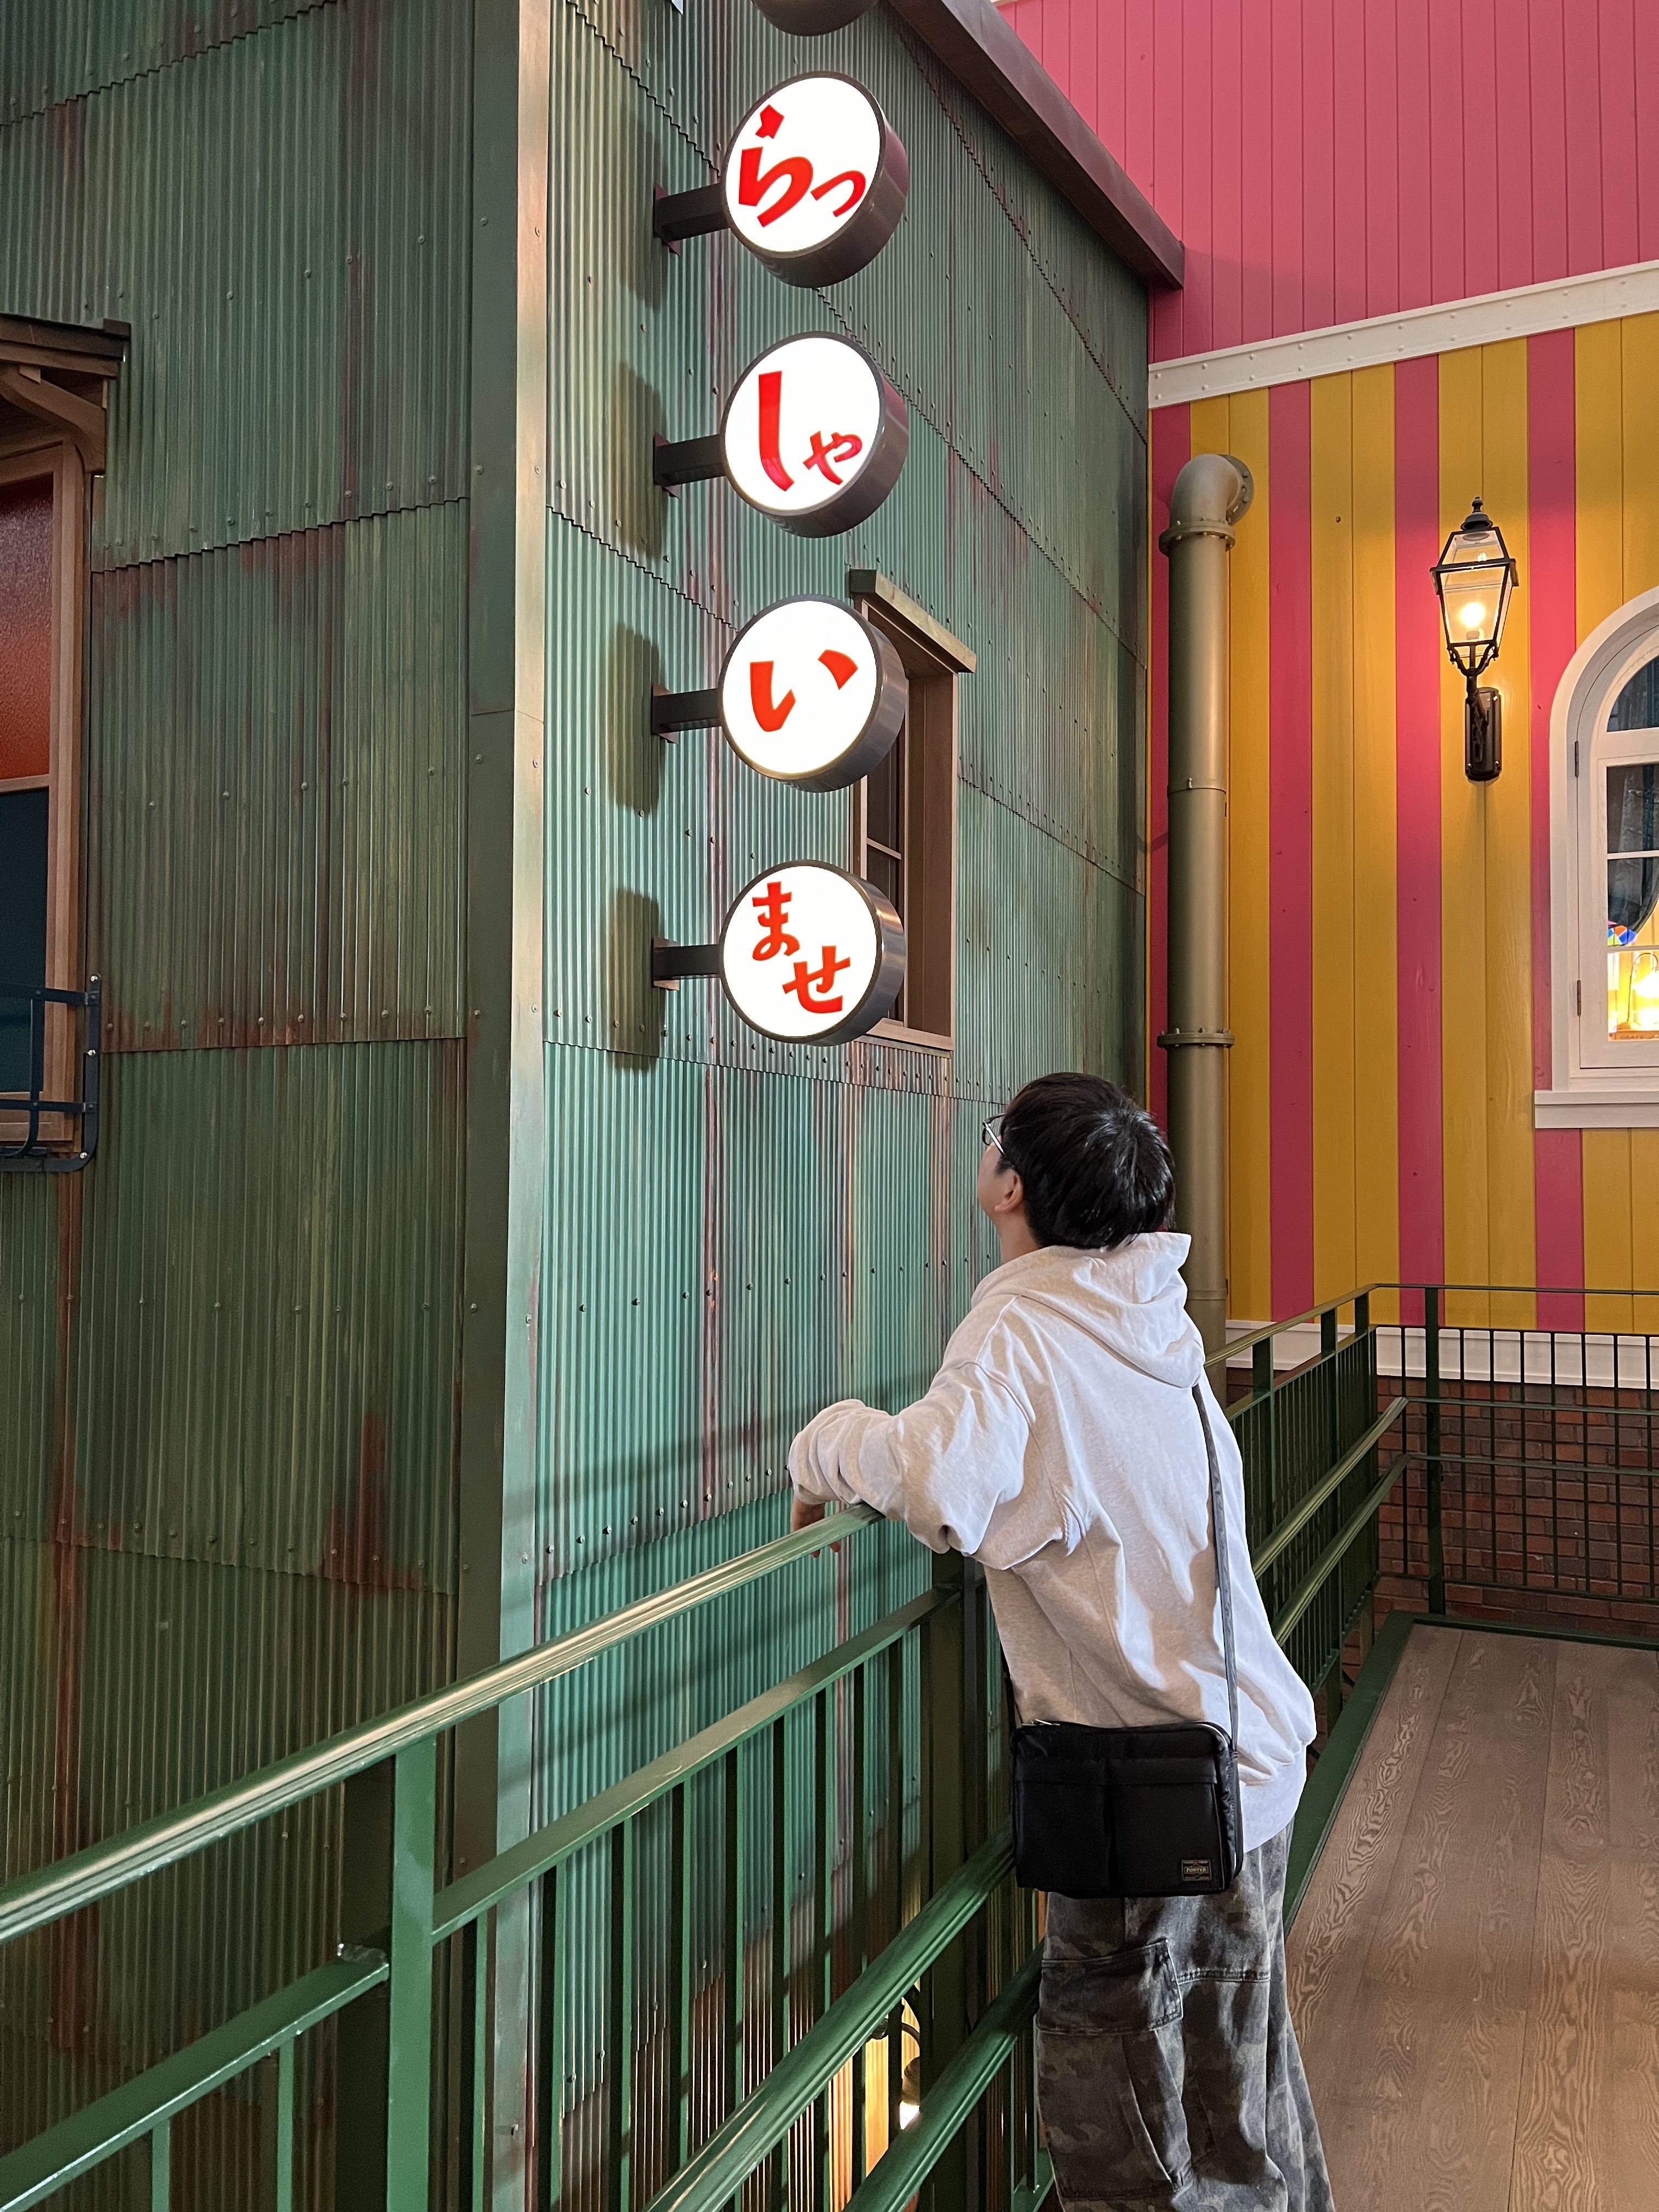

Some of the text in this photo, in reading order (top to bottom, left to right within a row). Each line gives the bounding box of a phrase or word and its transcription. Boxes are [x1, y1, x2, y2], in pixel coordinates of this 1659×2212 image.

[738, 104, 866, 228] らっ
[758, 371, 862, 492] しゃ
[750, 650, 857, 732] い
[752, 882, 850, 1014] ませ
